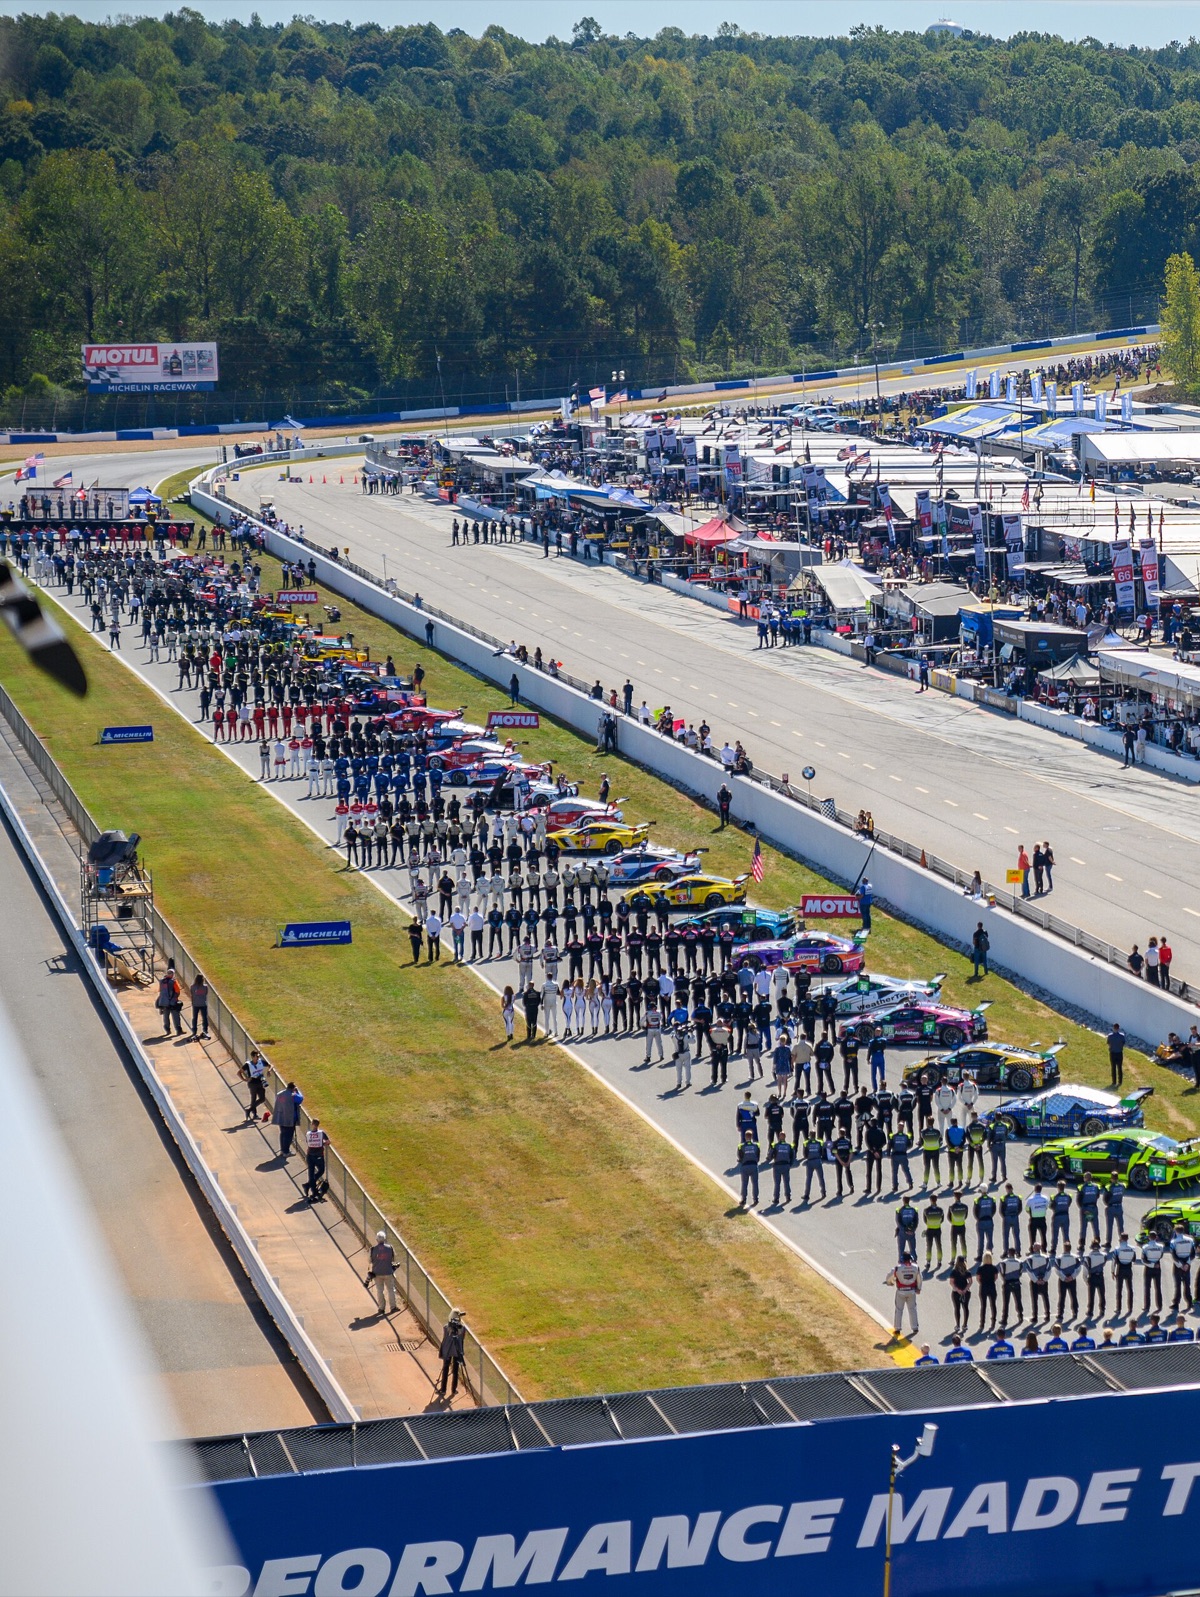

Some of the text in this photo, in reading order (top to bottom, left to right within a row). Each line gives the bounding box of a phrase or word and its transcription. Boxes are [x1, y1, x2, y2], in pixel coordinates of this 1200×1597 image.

[90, 350, 154, 364] MOTUL
[1008, 542, 1021, 552] 77
[1118, 571, 1131, 581] 66
[1146, 570, 1157, 580] 67
[278, 594, 316, 602] MOTUL
[490, 716, 538, 726] MOTUL
[804, 900, 860, 914] MOTU
[298, 930, 350, 938] MICHELIN
[1072, 1160, 1082, 1168] 14
[1153, 1168, 1162, 1178] 12
[1192, 1224, 1200, 1233] 12
[856, 1468, 1141, 1549] MADE
